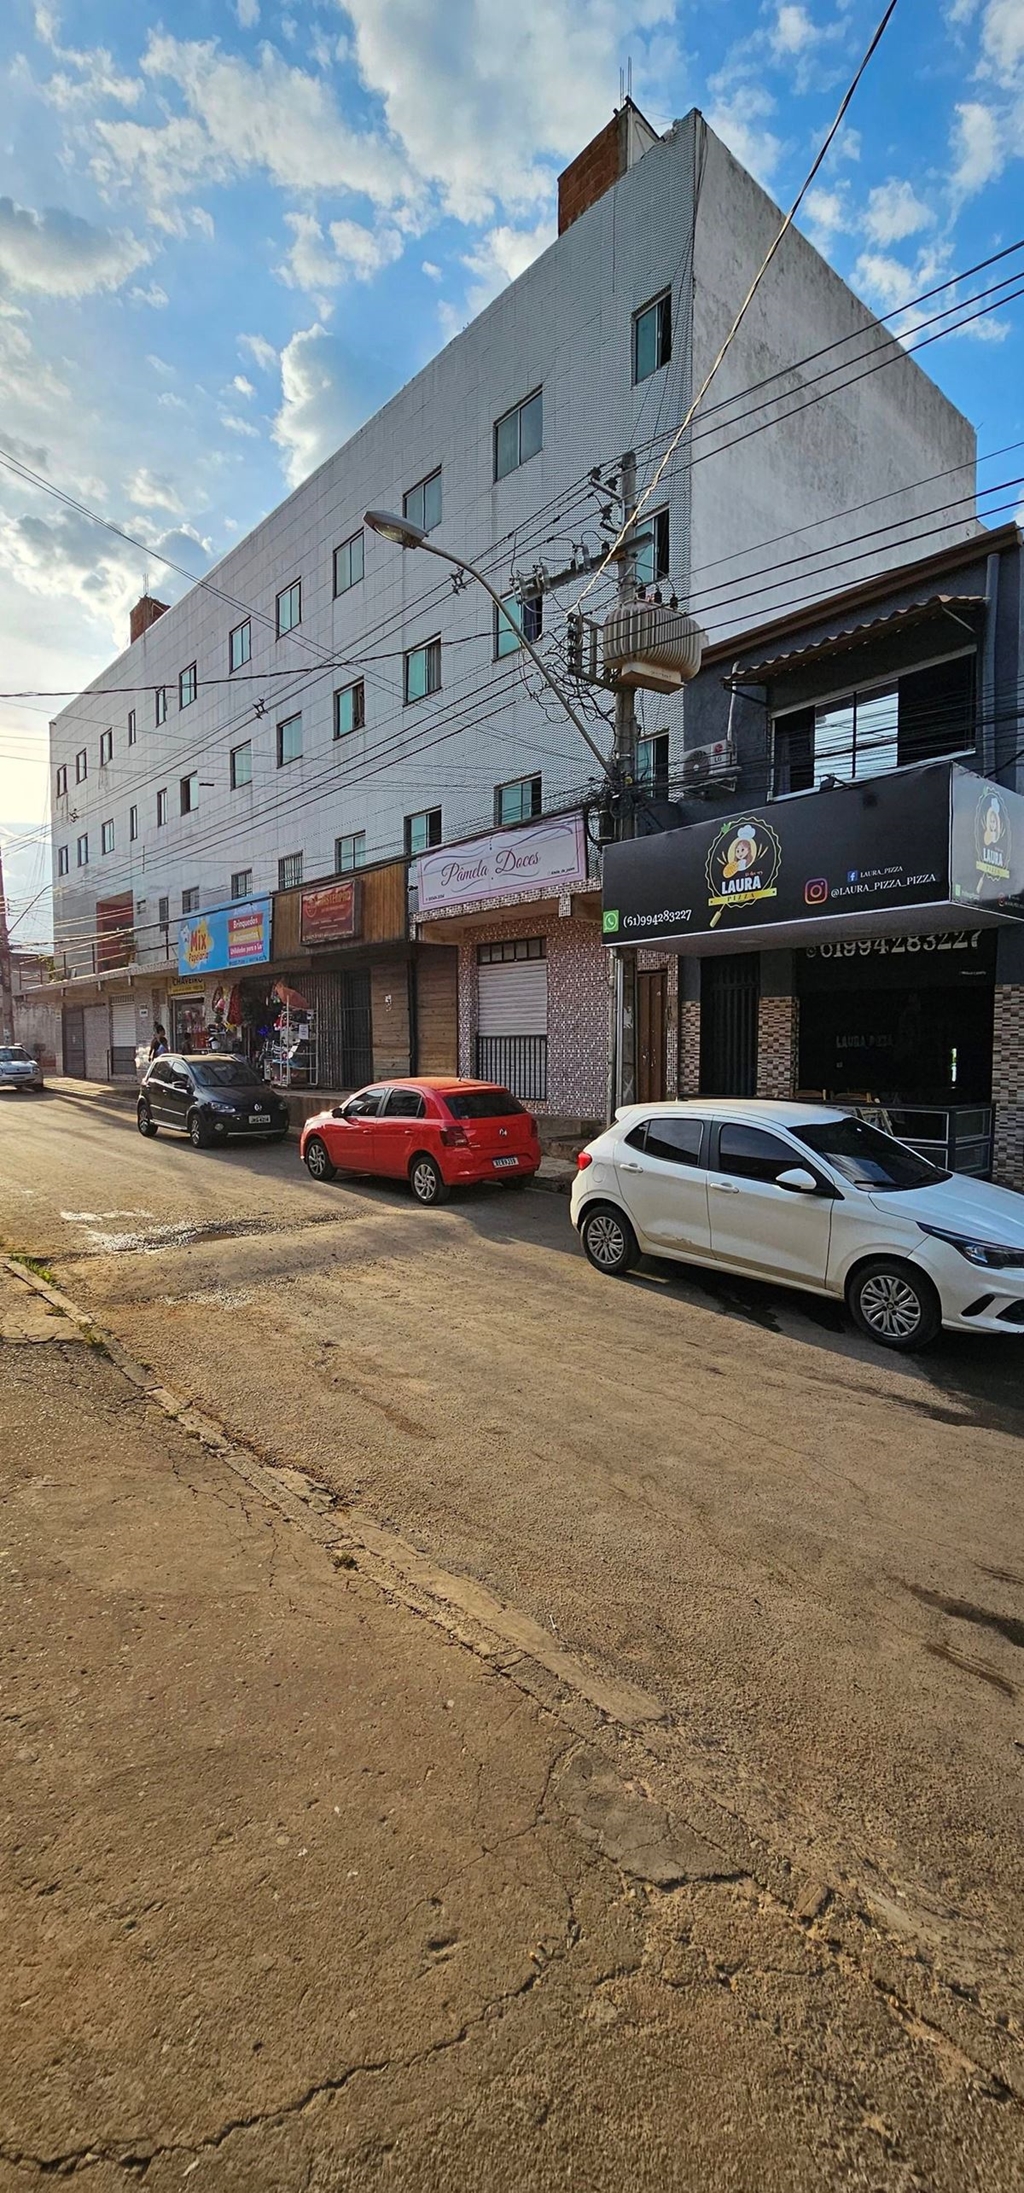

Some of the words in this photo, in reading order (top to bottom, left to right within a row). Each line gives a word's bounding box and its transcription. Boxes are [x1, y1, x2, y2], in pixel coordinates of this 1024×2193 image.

[440, 859, 488, 887] Pâmela
[495, 848, 541, 875] Doces
[860, 865, 903, 878] LAURA_PIZZA
[721, 875, 762, 895] LAURA
[831, 873, 936, 898] @LAURA_PIZZA_PIZZA
[727, 892, 755, 902] PIZZA
[233, 916, 259, 929] Brinquedos
[623, 909, 692, 928] (61)994283227
[190, 929, 207, 952] Mix
